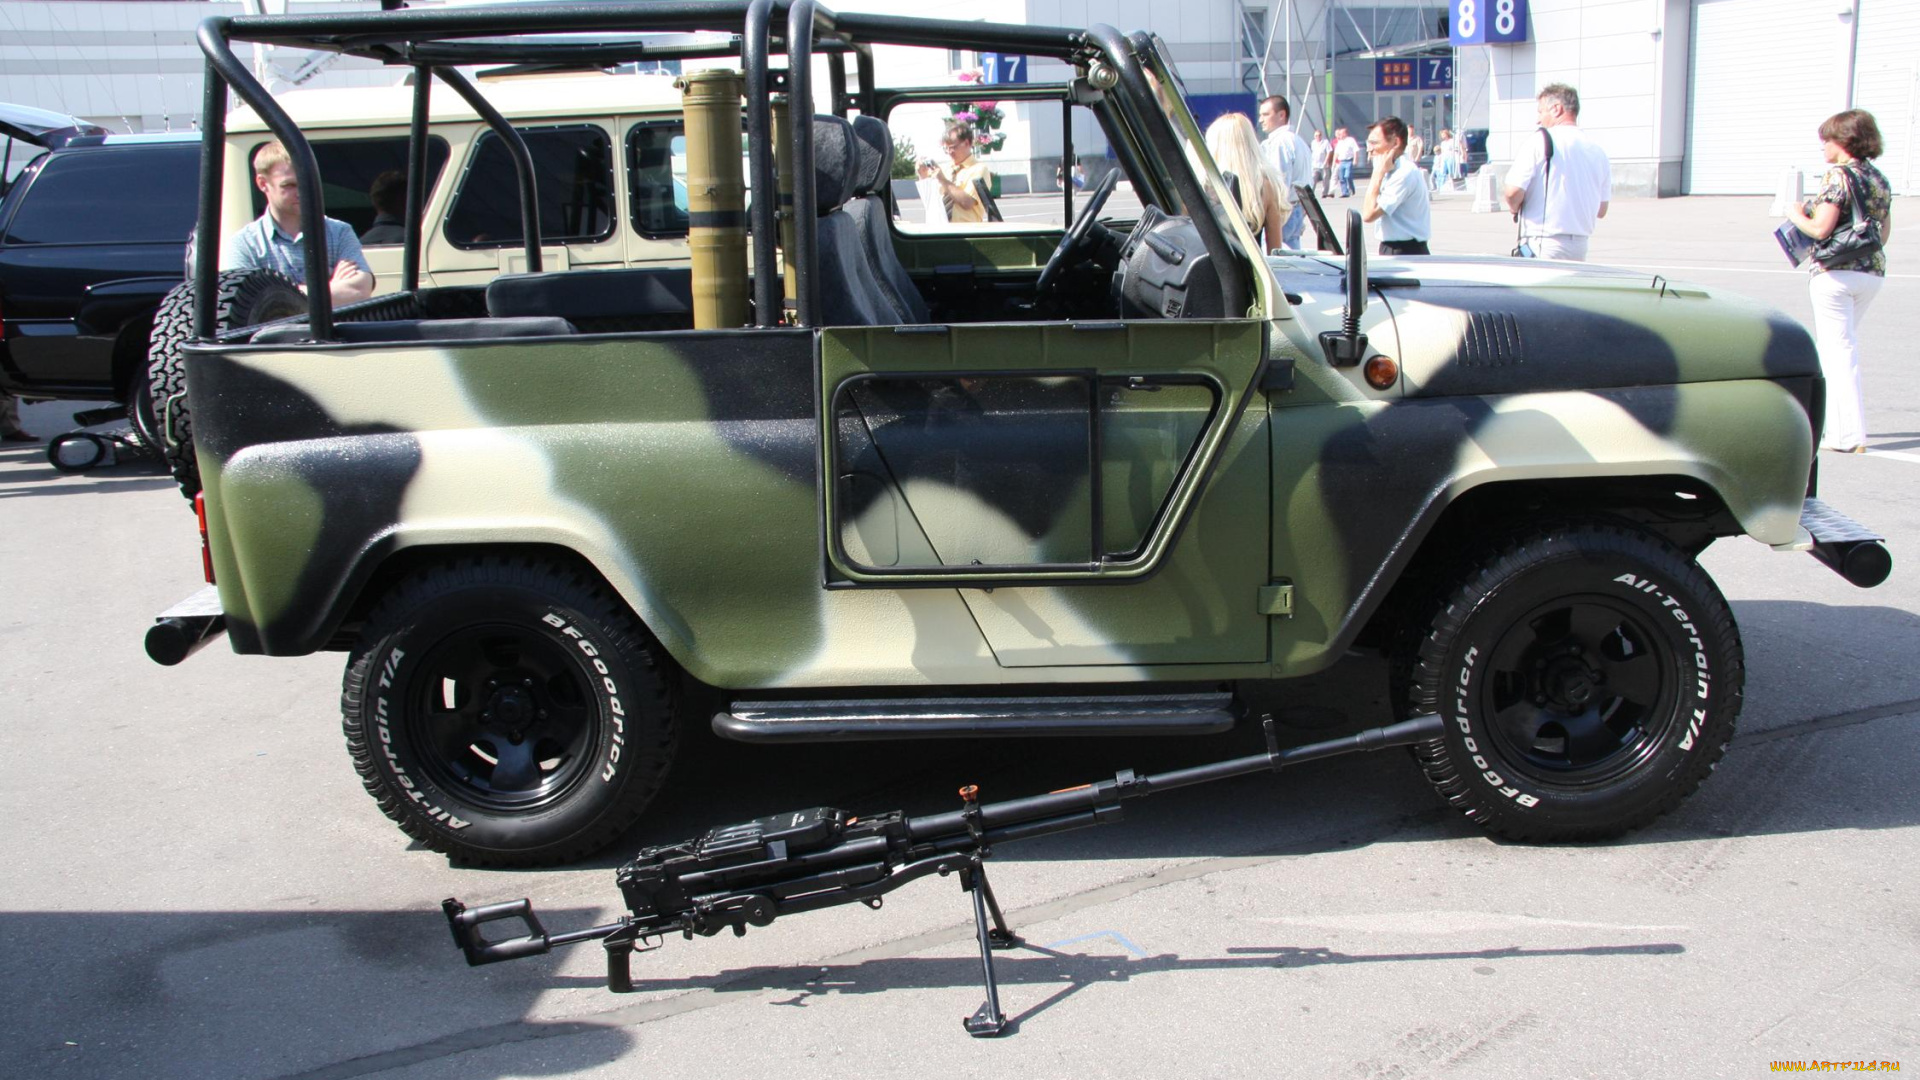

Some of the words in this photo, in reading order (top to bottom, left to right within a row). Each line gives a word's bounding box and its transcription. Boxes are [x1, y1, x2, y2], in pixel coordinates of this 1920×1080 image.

[1458, 0, 1475, 38] 8
[1495, 0, 1515, 35] 8
[985, 57, 995, 83] 7
[1004, 56, 1020, 81] 7
[1429, 60, 1441, 80] 7
[1445, 66, 1452, 79] 3
[379, 647, 405, 689] T/A
[1678, 708, 1706, 751] T/A
